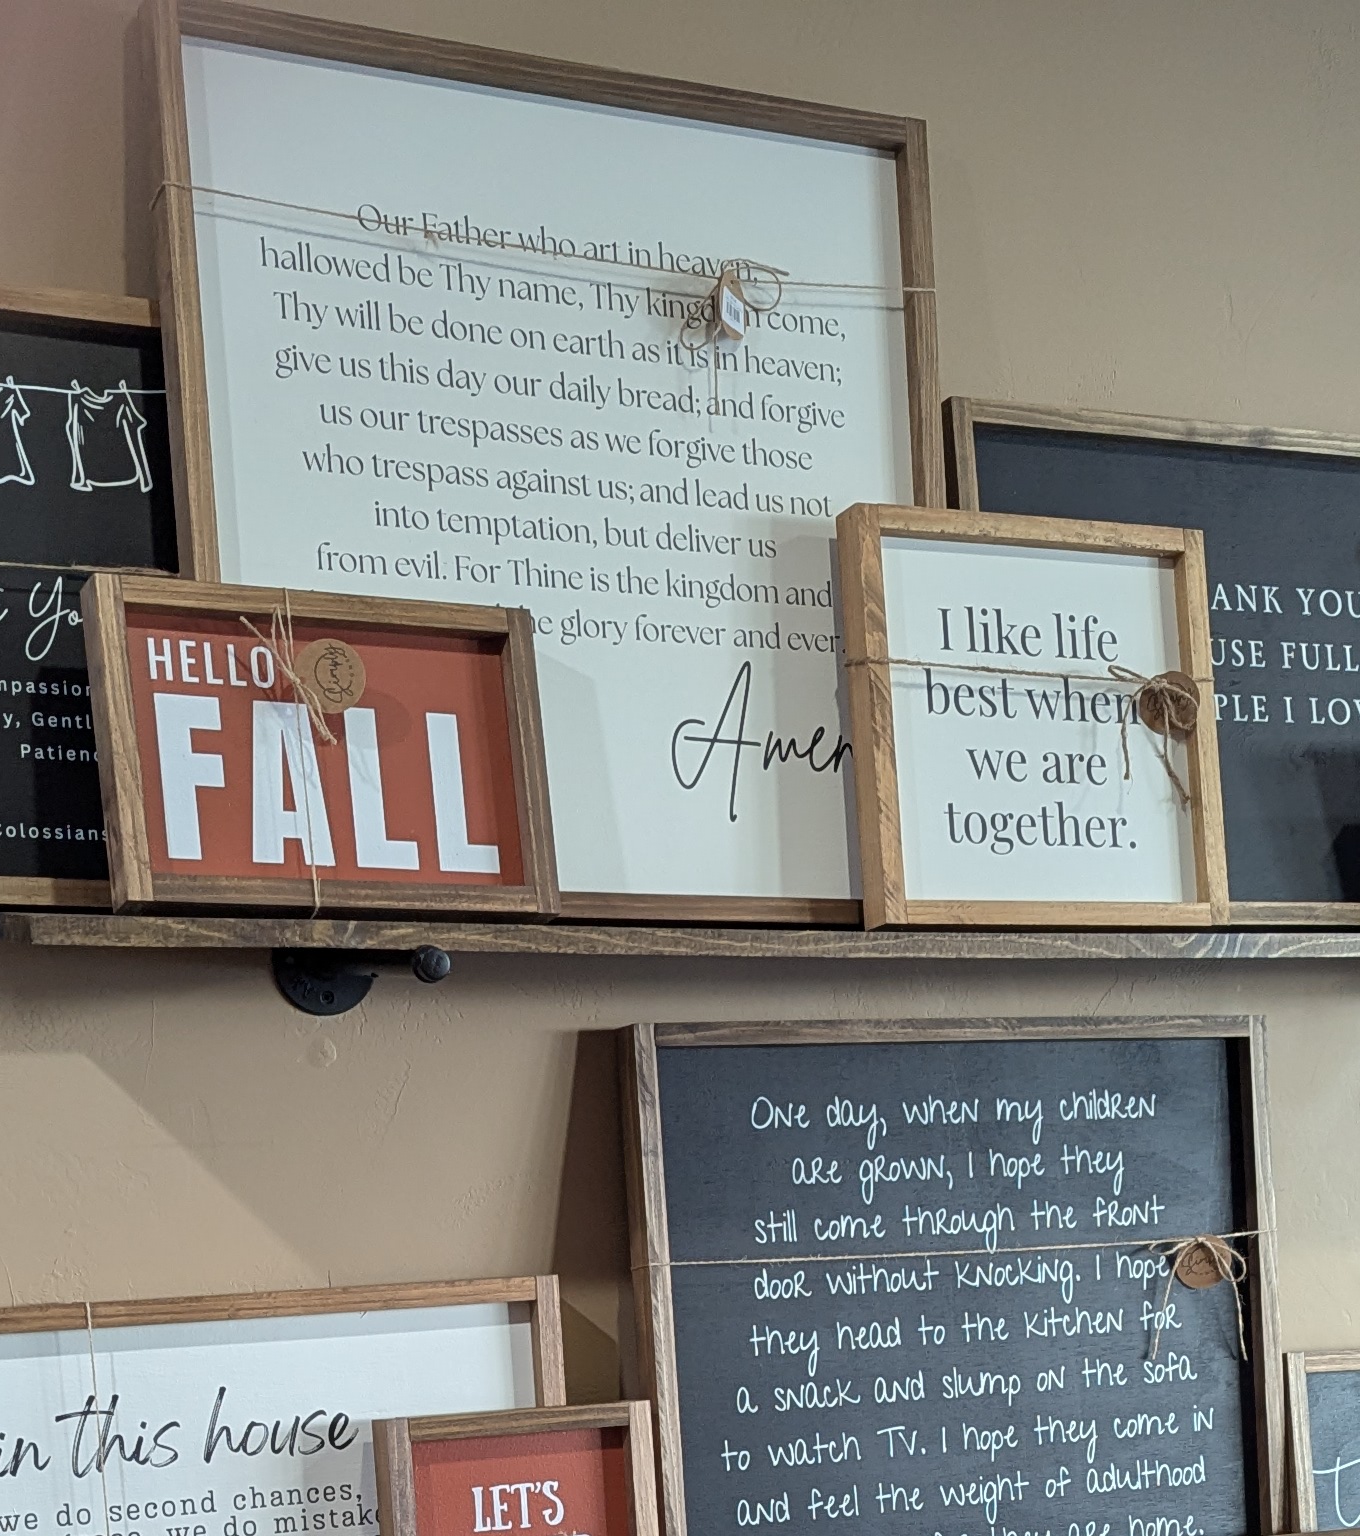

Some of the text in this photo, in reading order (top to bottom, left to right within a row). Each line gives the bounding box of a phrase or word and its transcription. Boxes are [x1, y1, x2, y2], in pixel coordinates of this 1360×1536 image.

[356, 204, 415, 238] Our
[421, 212, 512, 250] Father
[518, 228, 576, 260] who
[582, 232, 621, 264] art
[628, 241, 652, 269] in
[274, 291, 841, 386] Thy will be done on earth as it is in heaven;
[1211, 584, 1282, 613] ANK
[938, 607, 1118, 662] I like life
[147, 638, 274, 688] HELLO
[923, 668, 1139, 725] best when
[1284, 697, 1294, 723] I
[153, 693, 501, 875] FALL
[966, 749, 1107, 785] we are
[944, 802, 1136, 855] together.
[827, 1096, 886, 1150] day,
[997, 1098, 1043, 1145] my
[55, 1395, 180, 1478] this
[204, 1387, 359, 1463] house
[721, 1440, 750, 1471] to
[768, 1432, 861, 1466] watch
[877, 1426, 926, 1457] TV.
[942, 1427, 946, 1452] I
[963, 1423, 1018, 1462] hope
[1034, 1415, 1098, 1463] they
[1114, 1413, 1179, 1438] come
[57, 1503, 90, 1526] do
[109, 1492, 215, 1522] second
[234, 1484, 361, 1510] chances,
[472, 1481, 564, 1532] LET'S
